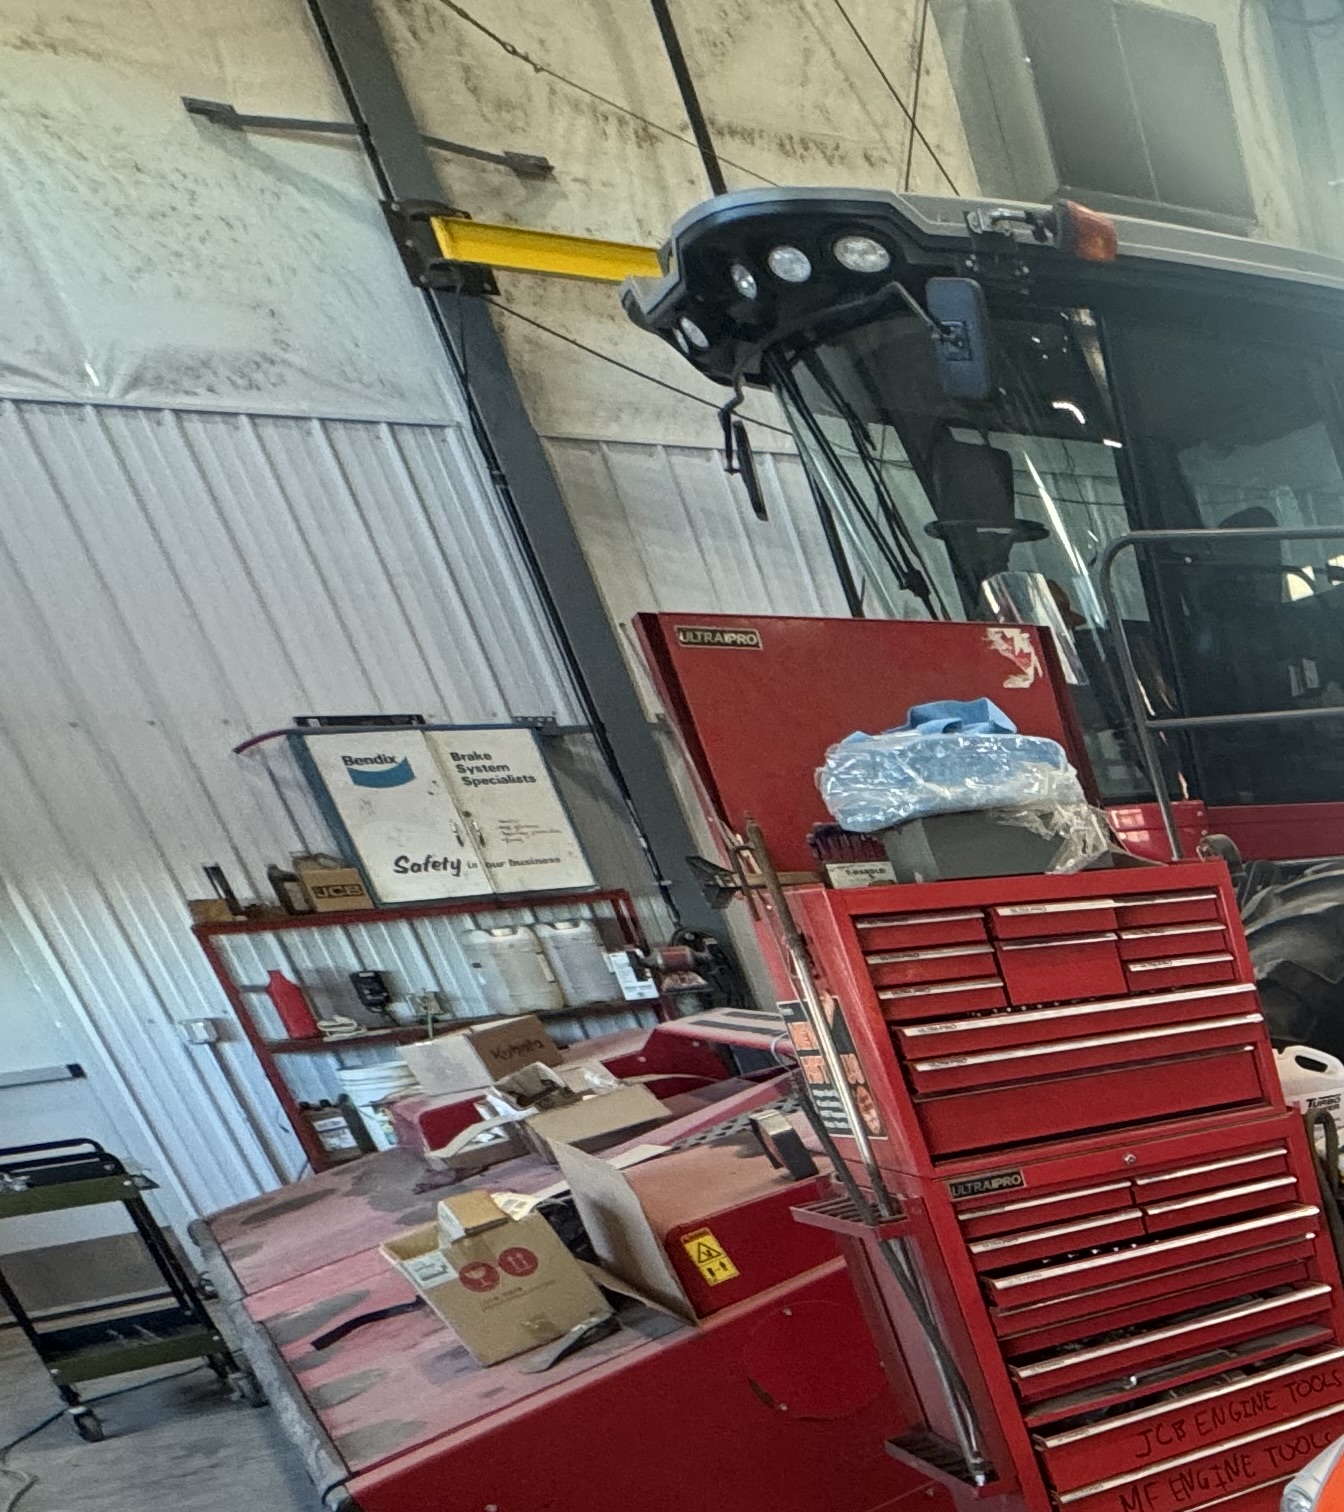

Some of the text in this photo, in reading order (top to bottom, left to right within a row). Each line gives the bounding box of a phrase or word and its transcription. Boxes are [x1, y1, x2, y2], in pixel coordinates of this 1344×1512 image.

[342, 755, 398, 766] Bendix
[450, 752, 492, 762] Brake
[456, 765, 510, 774] System
[462, 775, 536, 787] Specialists
[394, 855, 462, 877] Safety
[484, 861, 506, 869] our
[508, 856, 561, 867] business
[314, 884, 363, 899] JCB
[1135, 1368, 1343, 1458] JCB ENGINE TOOLS
[1168, 1452, 1256, 1503] ENGINE
